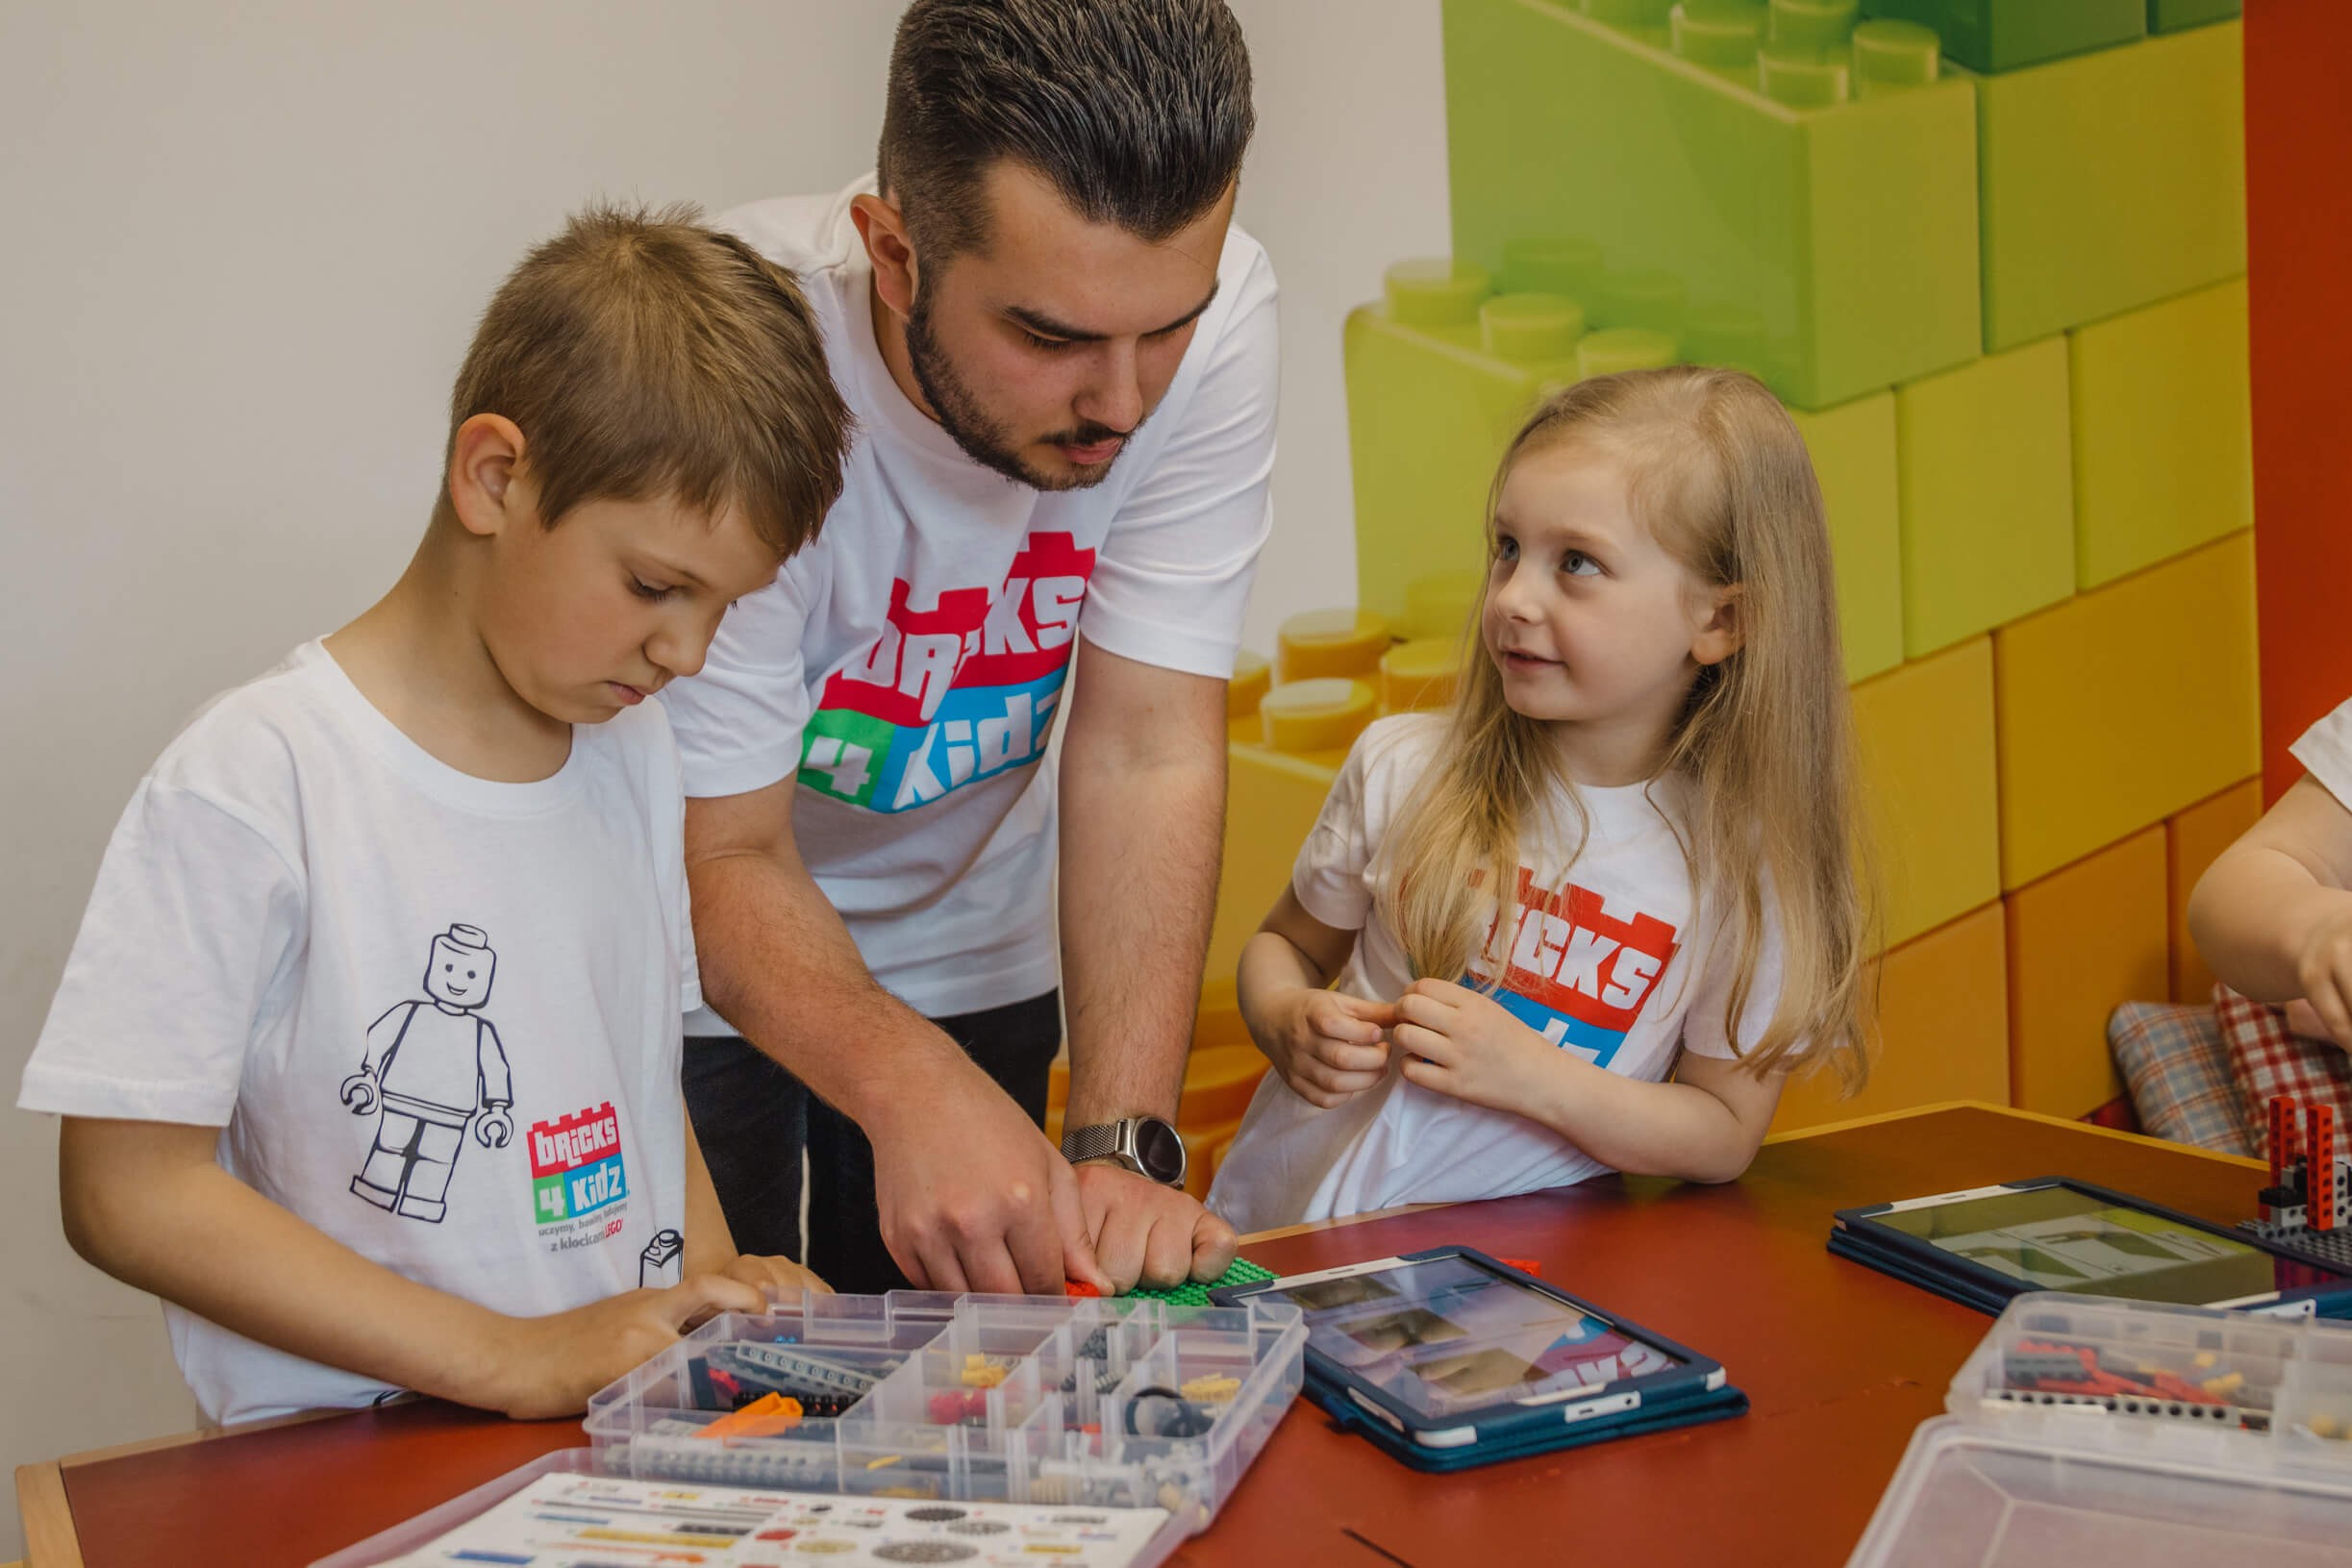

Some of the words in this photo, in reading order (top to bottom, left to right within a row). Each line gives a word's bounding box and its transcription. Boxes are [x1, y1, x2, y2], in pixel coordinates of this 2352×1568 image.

[804, 734, 873, 796] 4
[538, 1185, 565, 1217] 4
[572, 1162, 623, 1213] Kidz
[538, 1223, 575, 1236] uczymy,
